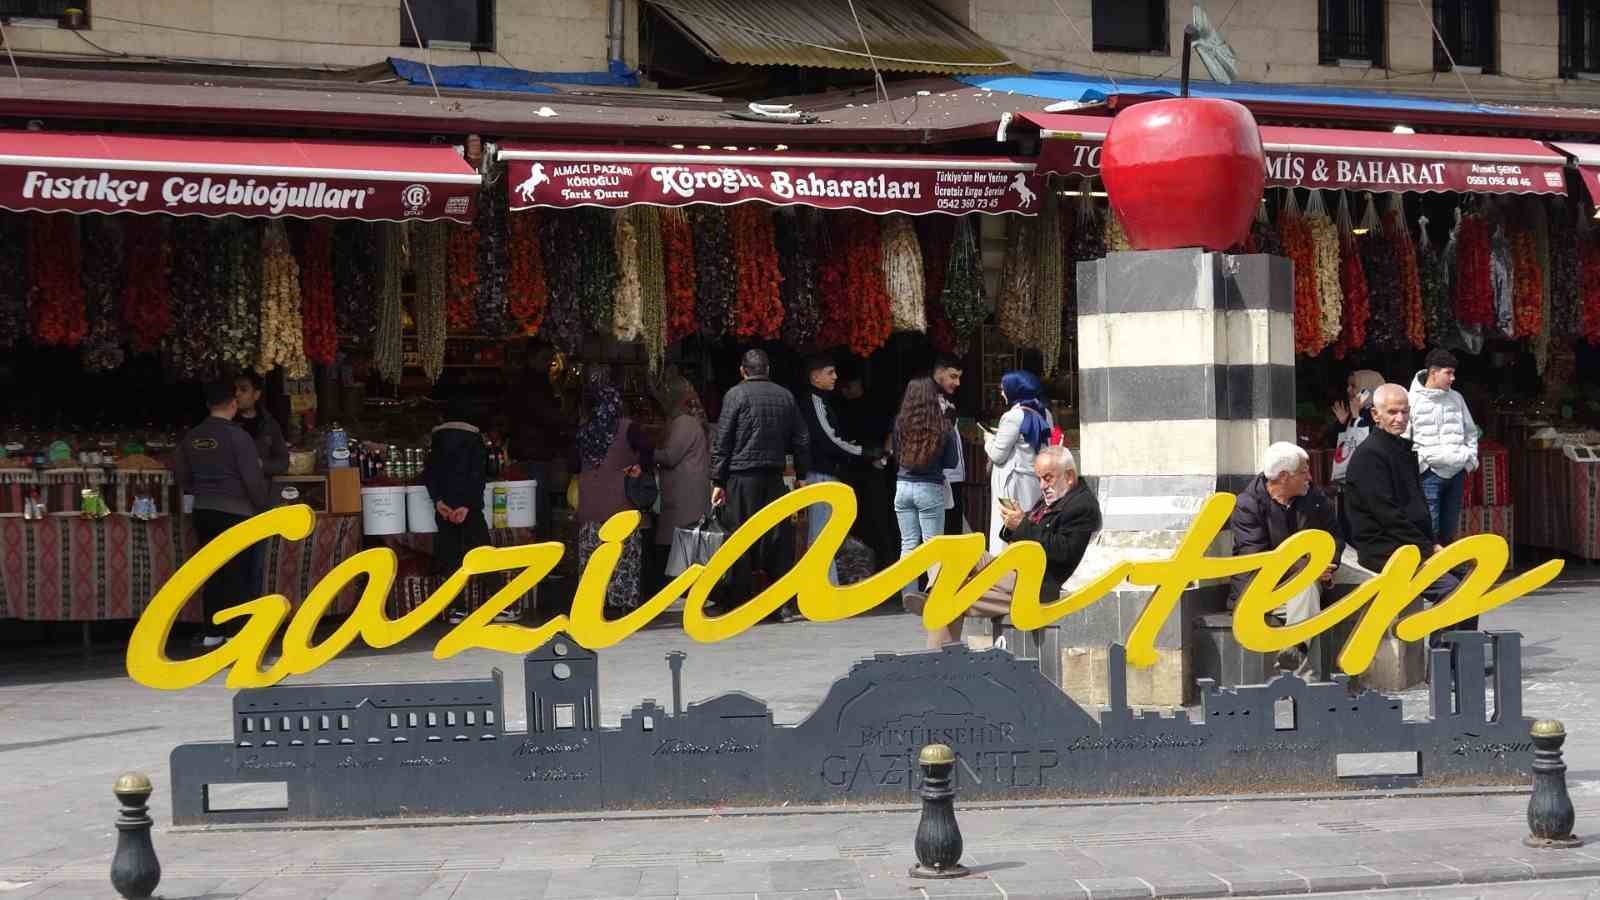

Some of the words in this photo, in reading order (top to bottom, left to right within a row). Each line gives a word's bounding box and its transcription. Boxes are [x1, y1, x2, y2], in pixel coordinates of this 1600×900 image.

[1072, 144, 1104, 169] TO
[1264, 152, 1305, 186] MİŞ
[1311, 158, 1330, 183] &
[1337, 159, 1446, 185] BAHARAT
[553, 164, 590, 177] ALMACI
[593, 164, 633, 177] PAZARI
[566, 175, 619, 187] KÖROĞLU
[650, 166, 764, 197] Köroğlu
[770, 171, 922, 199] Baharatları
[22, 170, 149, 207] Fıstıkçı
[162, 176, 366, 214] Çelebioğulları
[560, 188, 592, 200] Tarık
[593, 189, 630, 200] Durur
[937, 199, 960, 209] 0542
[977, 199, 988, 209] 73
[126, 482, 1565, 690] Gaziantep
